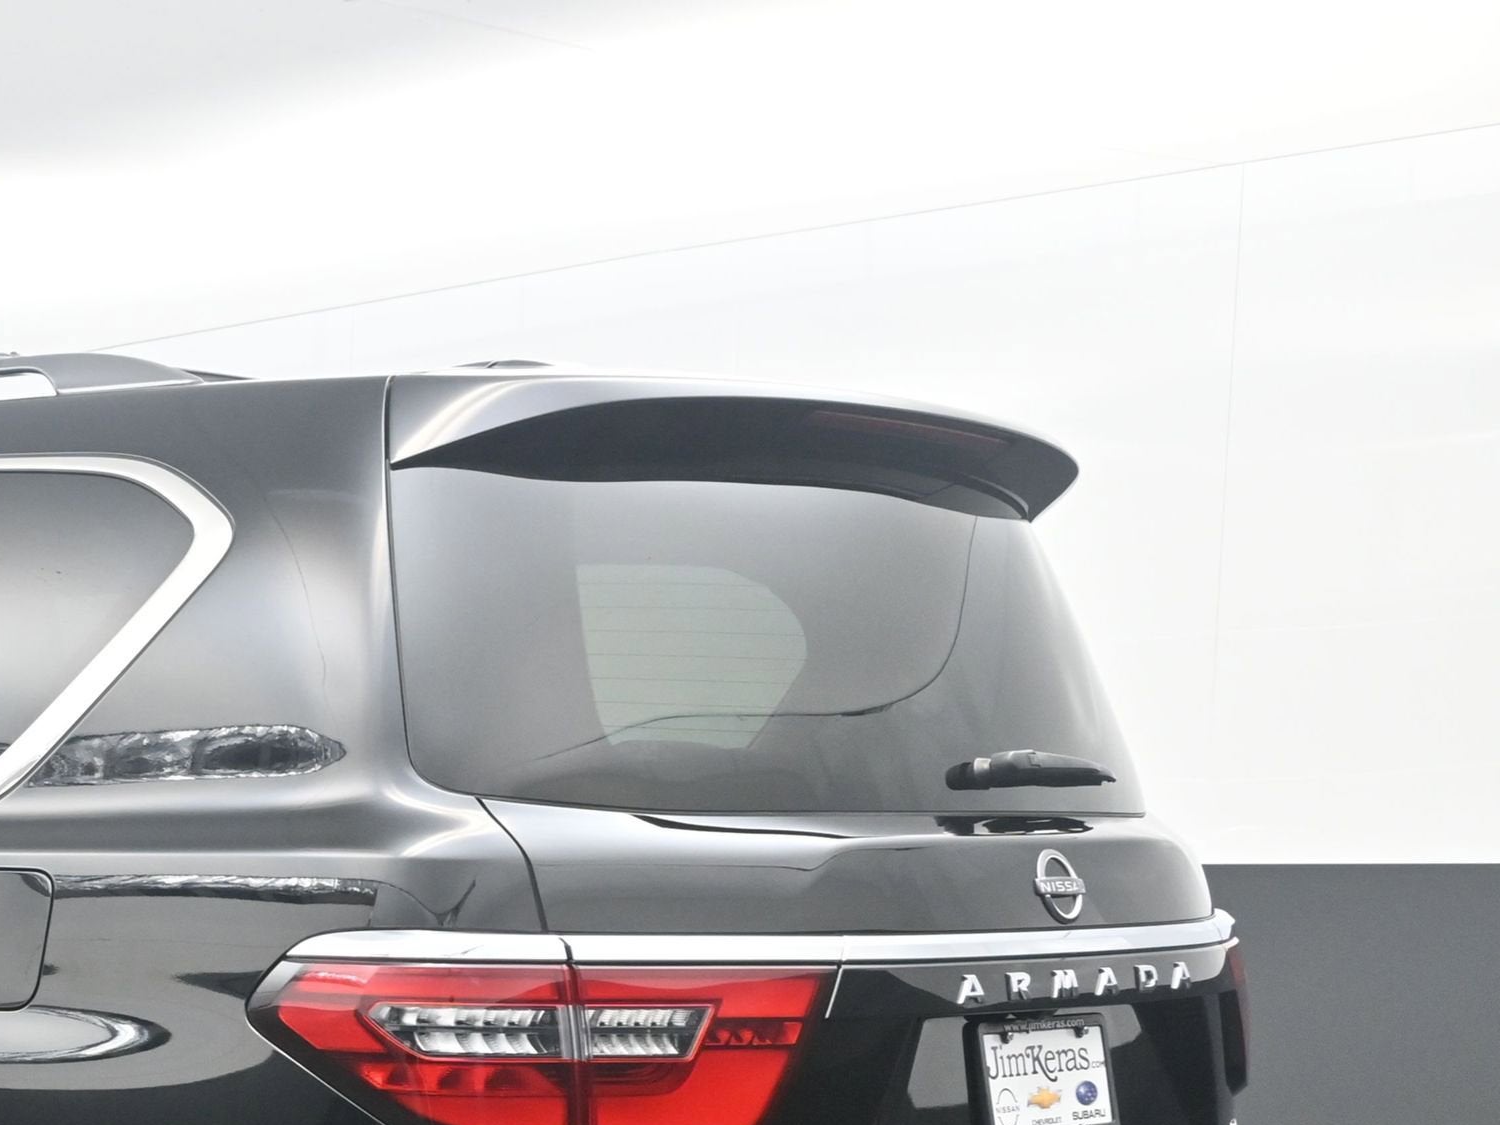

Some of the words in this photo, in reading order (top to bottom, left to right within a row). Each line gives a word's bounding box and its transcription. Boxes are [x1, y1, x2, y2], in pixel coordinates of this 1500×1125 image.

[1040, 881, 1084, 893] NISSA
[957, 961, 1192, 1004] ARMADA
[996, 1106, 1020, 1114] NISSAN
[1072, 1109, 1106, 1121] SUBARU
